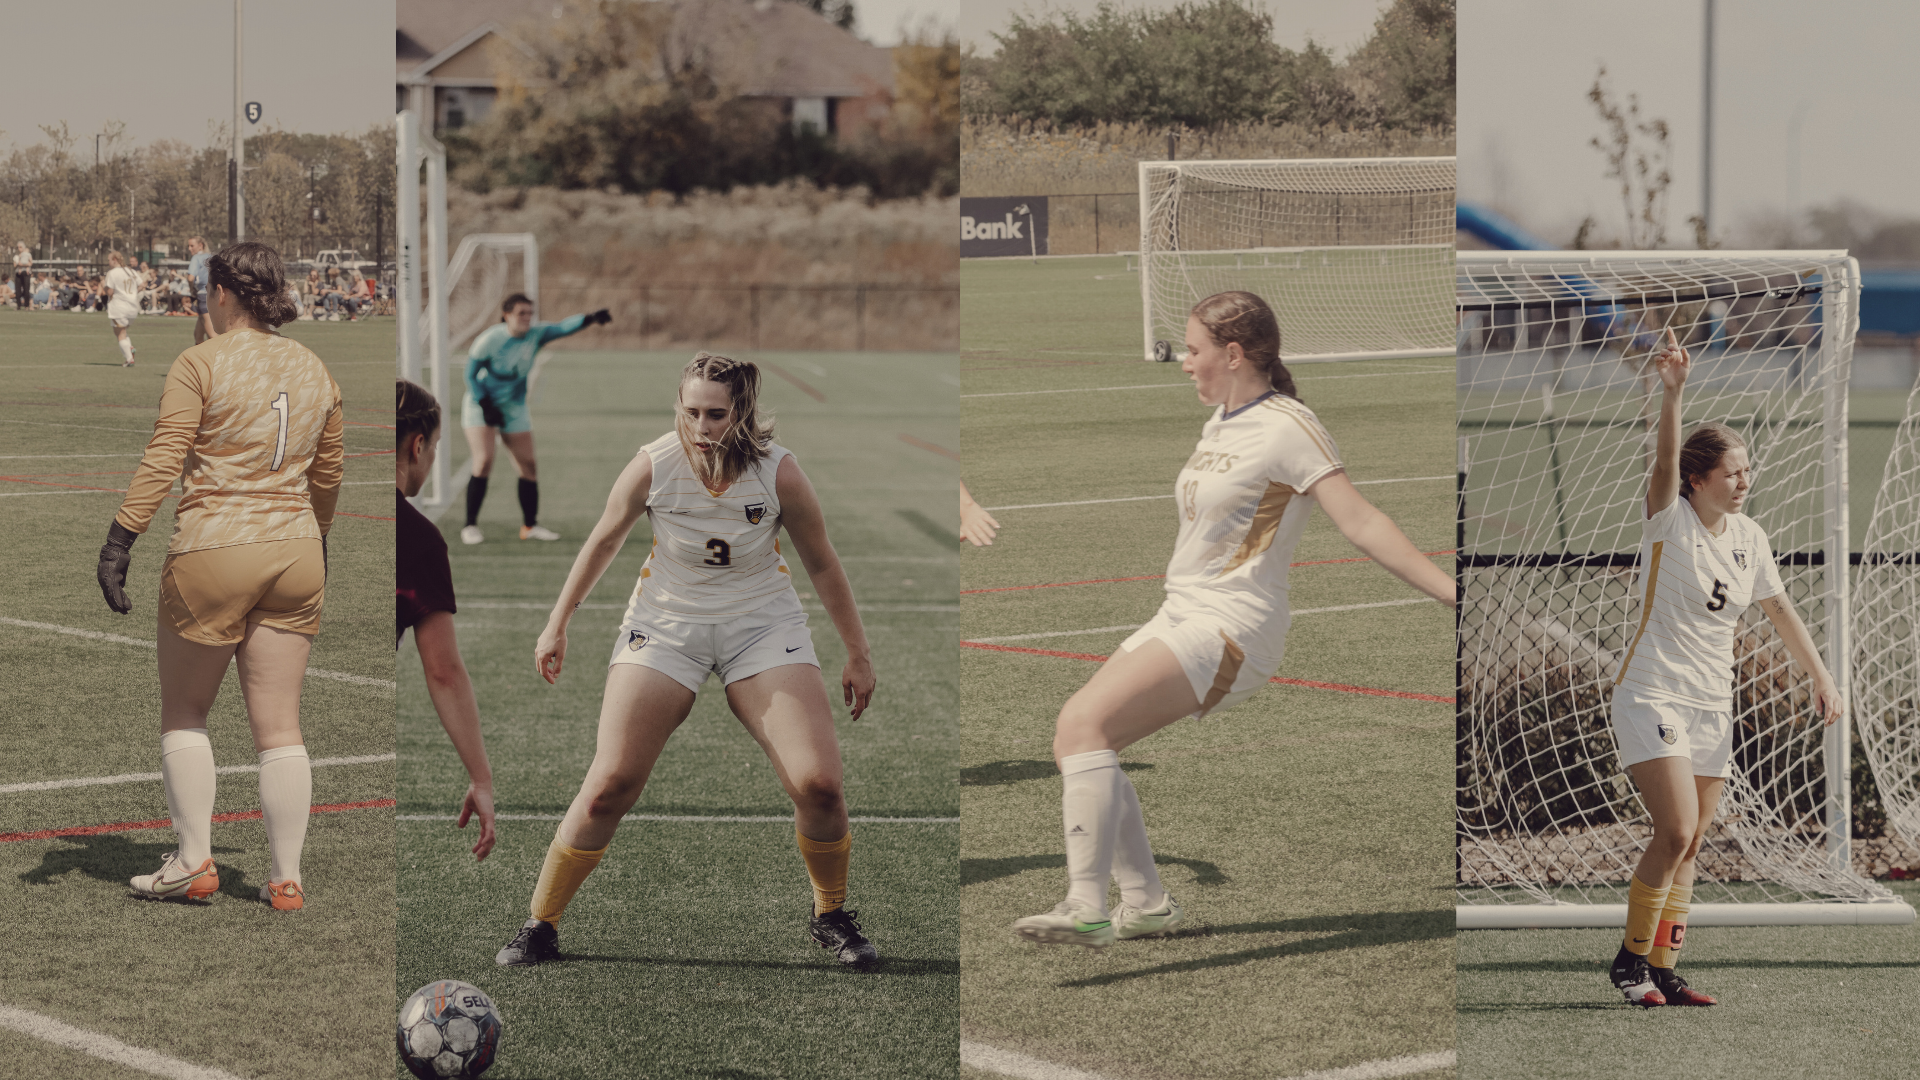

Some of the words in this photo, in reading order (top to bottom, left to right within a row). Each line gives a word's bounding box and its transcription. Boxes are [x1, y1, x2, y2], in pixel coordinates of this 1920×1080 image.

[249, 104, 259, 121] 5
[961, 212, 1024, 240] Bank
[123, 278, 133, 295] 12
[269, 391, 290, 472] 1
[704, 538, 731, 566] 3
[1706, 577, 1728, 612] 5
[1670, 924, 1685, 945] C
